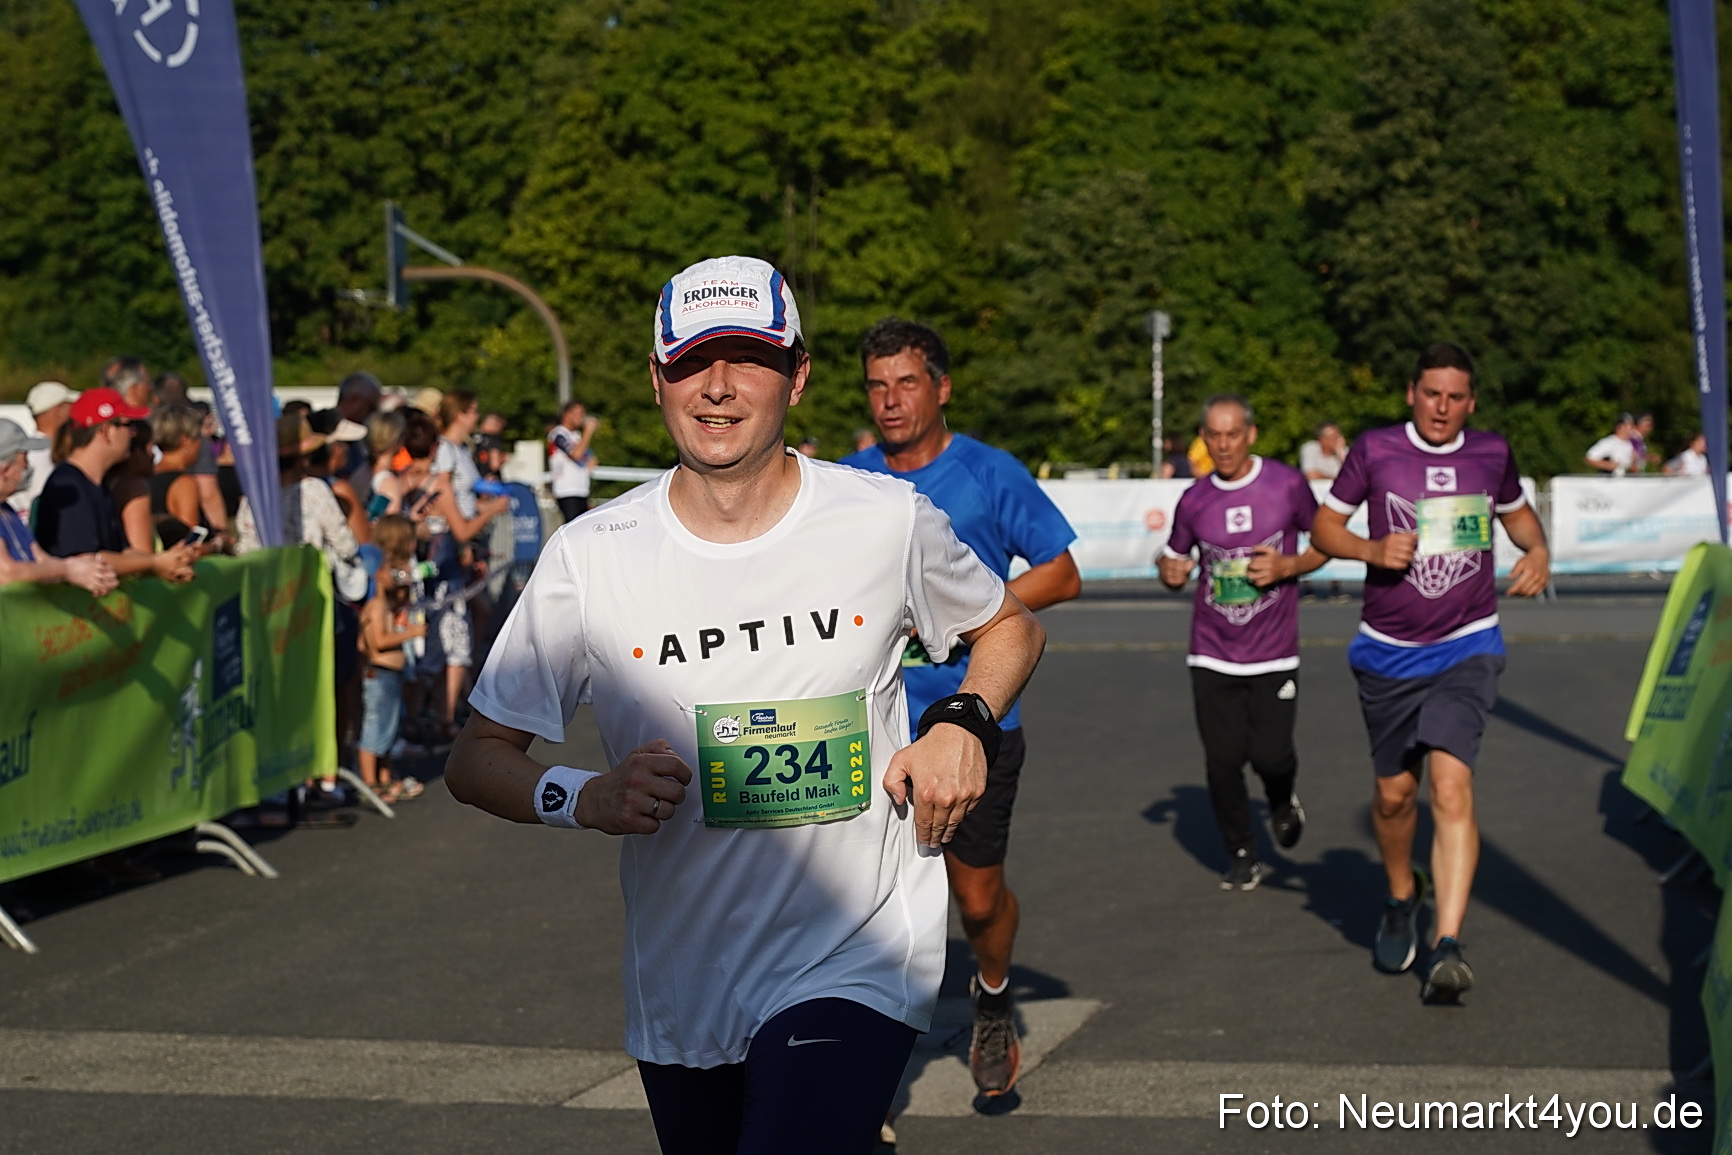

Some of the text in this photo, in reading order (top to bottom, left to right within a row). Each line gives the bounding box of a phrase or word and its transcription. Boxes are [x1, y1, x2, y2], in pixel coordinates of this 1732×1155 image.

[684, 287, 760, 305] ERDINGER
[682, 300, 758, 314] ALKOHOLFREI
[608, 519, 638, 532] JAKO
[658, 608, 839, 666] APTIV
[743, 722, 797, 736] Firmenlauf
[764, 731, 797, 739] neumarkt
[743, 741, 833, 786] 234
[849, 740, 864, 797] 2022
[710, 761, 727, 803] RUN
[739, 783, 840, 804] Baufeld Maik
[785, 804, 818, 812] Deutschland
